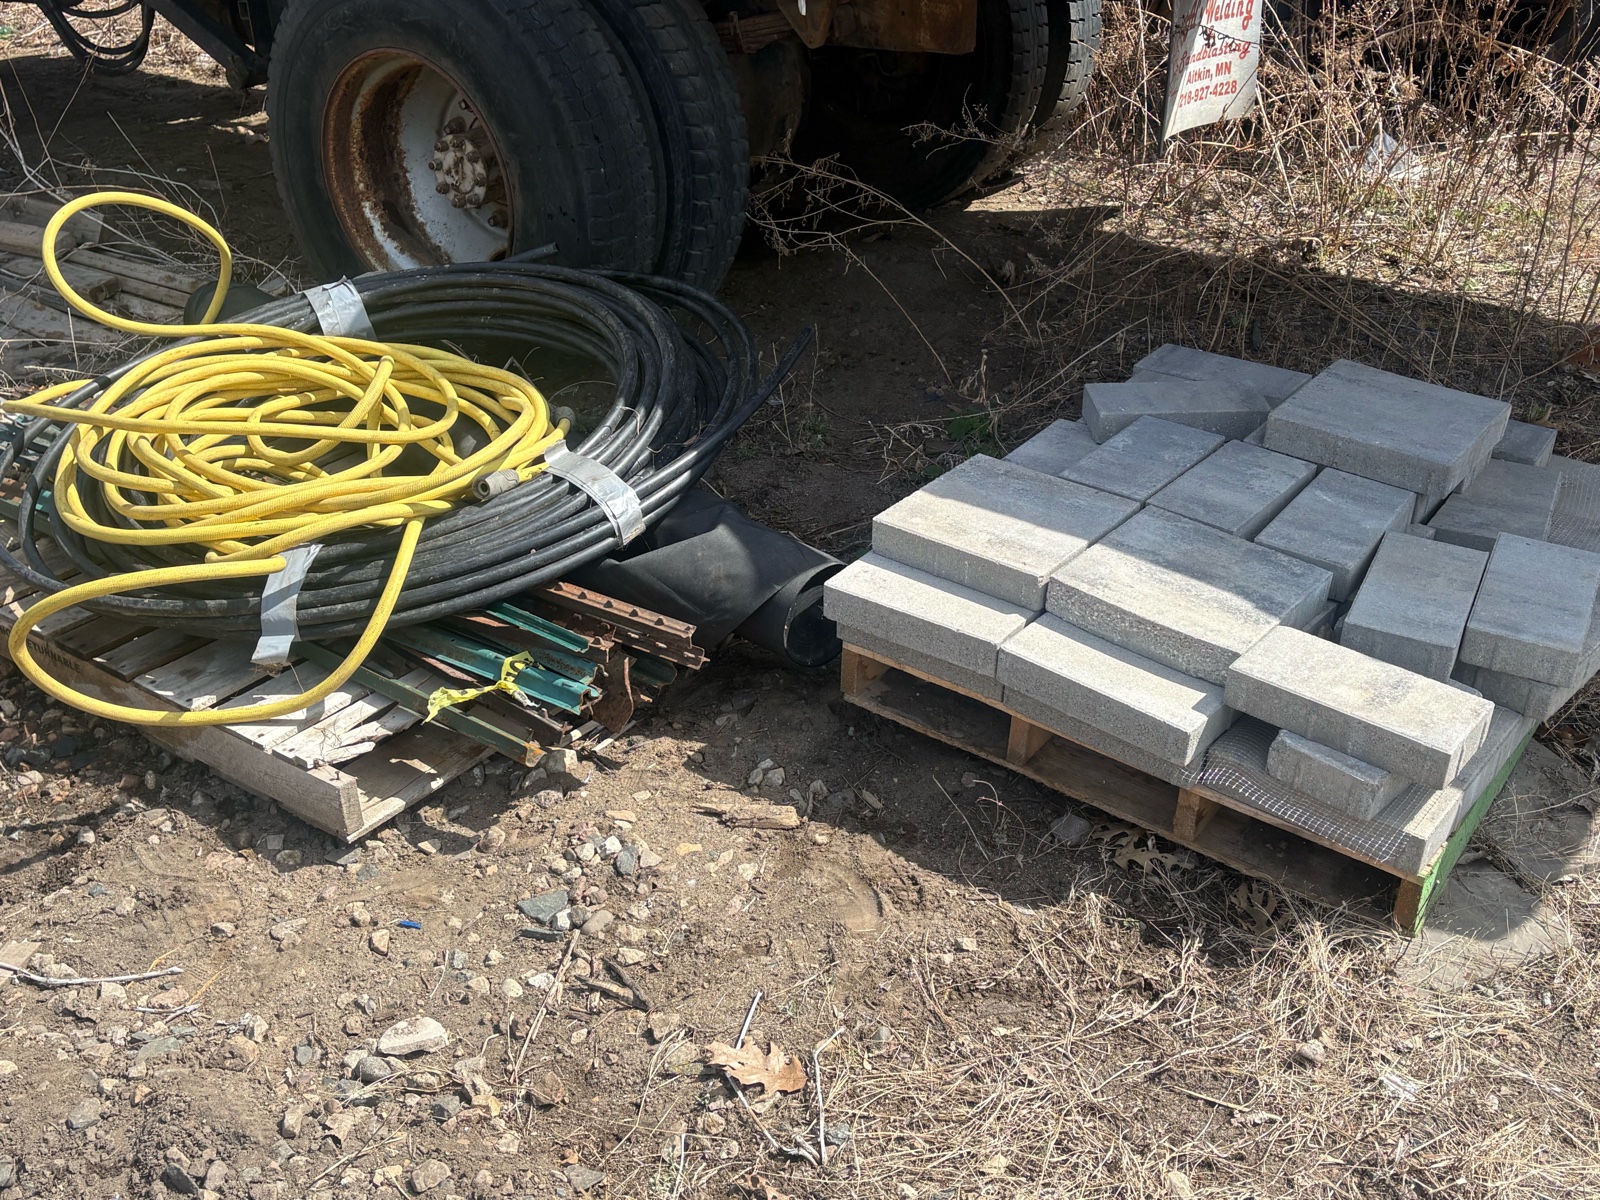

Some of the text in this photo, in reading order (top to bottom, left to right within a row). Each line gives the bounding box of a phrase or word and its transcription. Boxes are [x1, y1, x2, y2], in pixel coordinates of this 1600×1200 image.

[1205, 0, 1254, 30] Welding
[1186, 61, 1232, 85] Aitkin, MN
[1178, 80, 1238, 108] 218-927-4228
[27, 639, 81, 673] ETURNABLE
